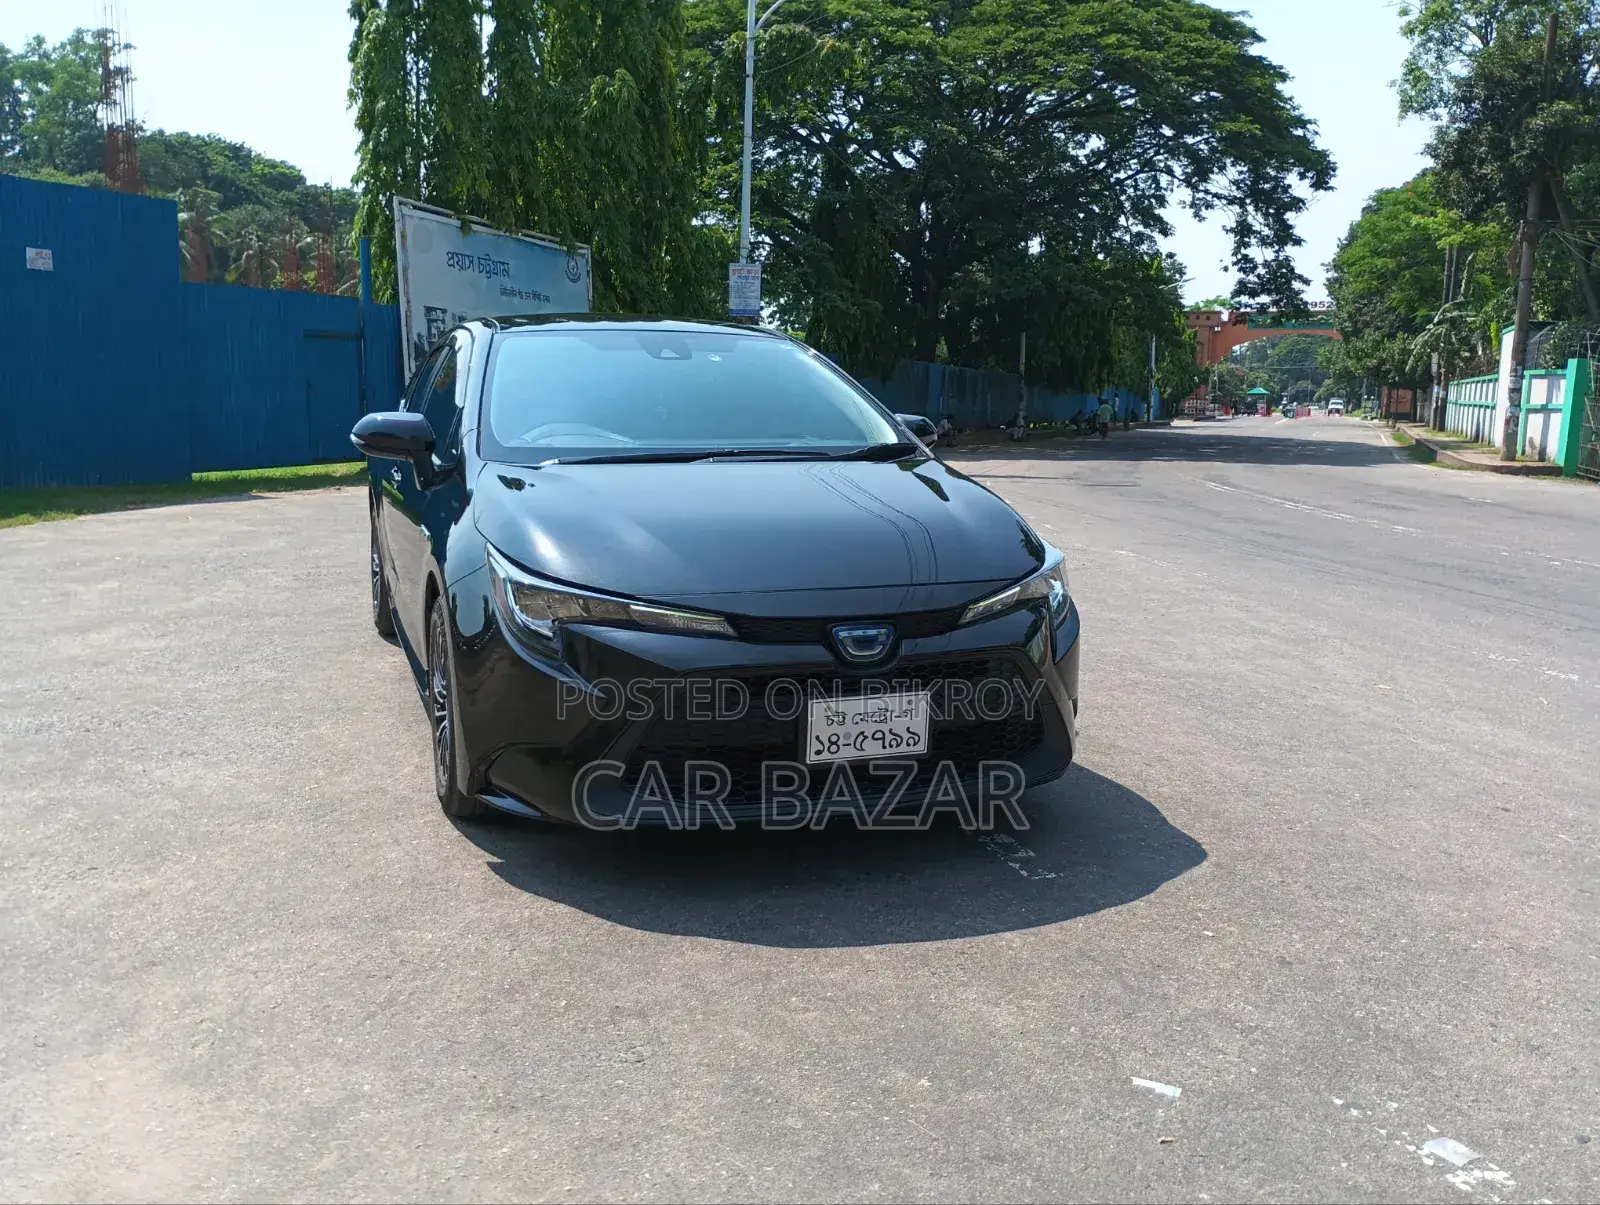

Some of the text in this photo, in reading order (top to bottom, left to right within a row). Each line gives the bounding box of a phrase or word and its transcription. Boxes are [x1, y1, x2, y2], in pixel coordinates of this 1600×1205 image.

[446, 251, 510, 280] প্রয়াস চট্টগ্রাম
[1304, 300, 1334, 309] 952
[814, 726, 921, 756] ১৪-৫৭৯৯
